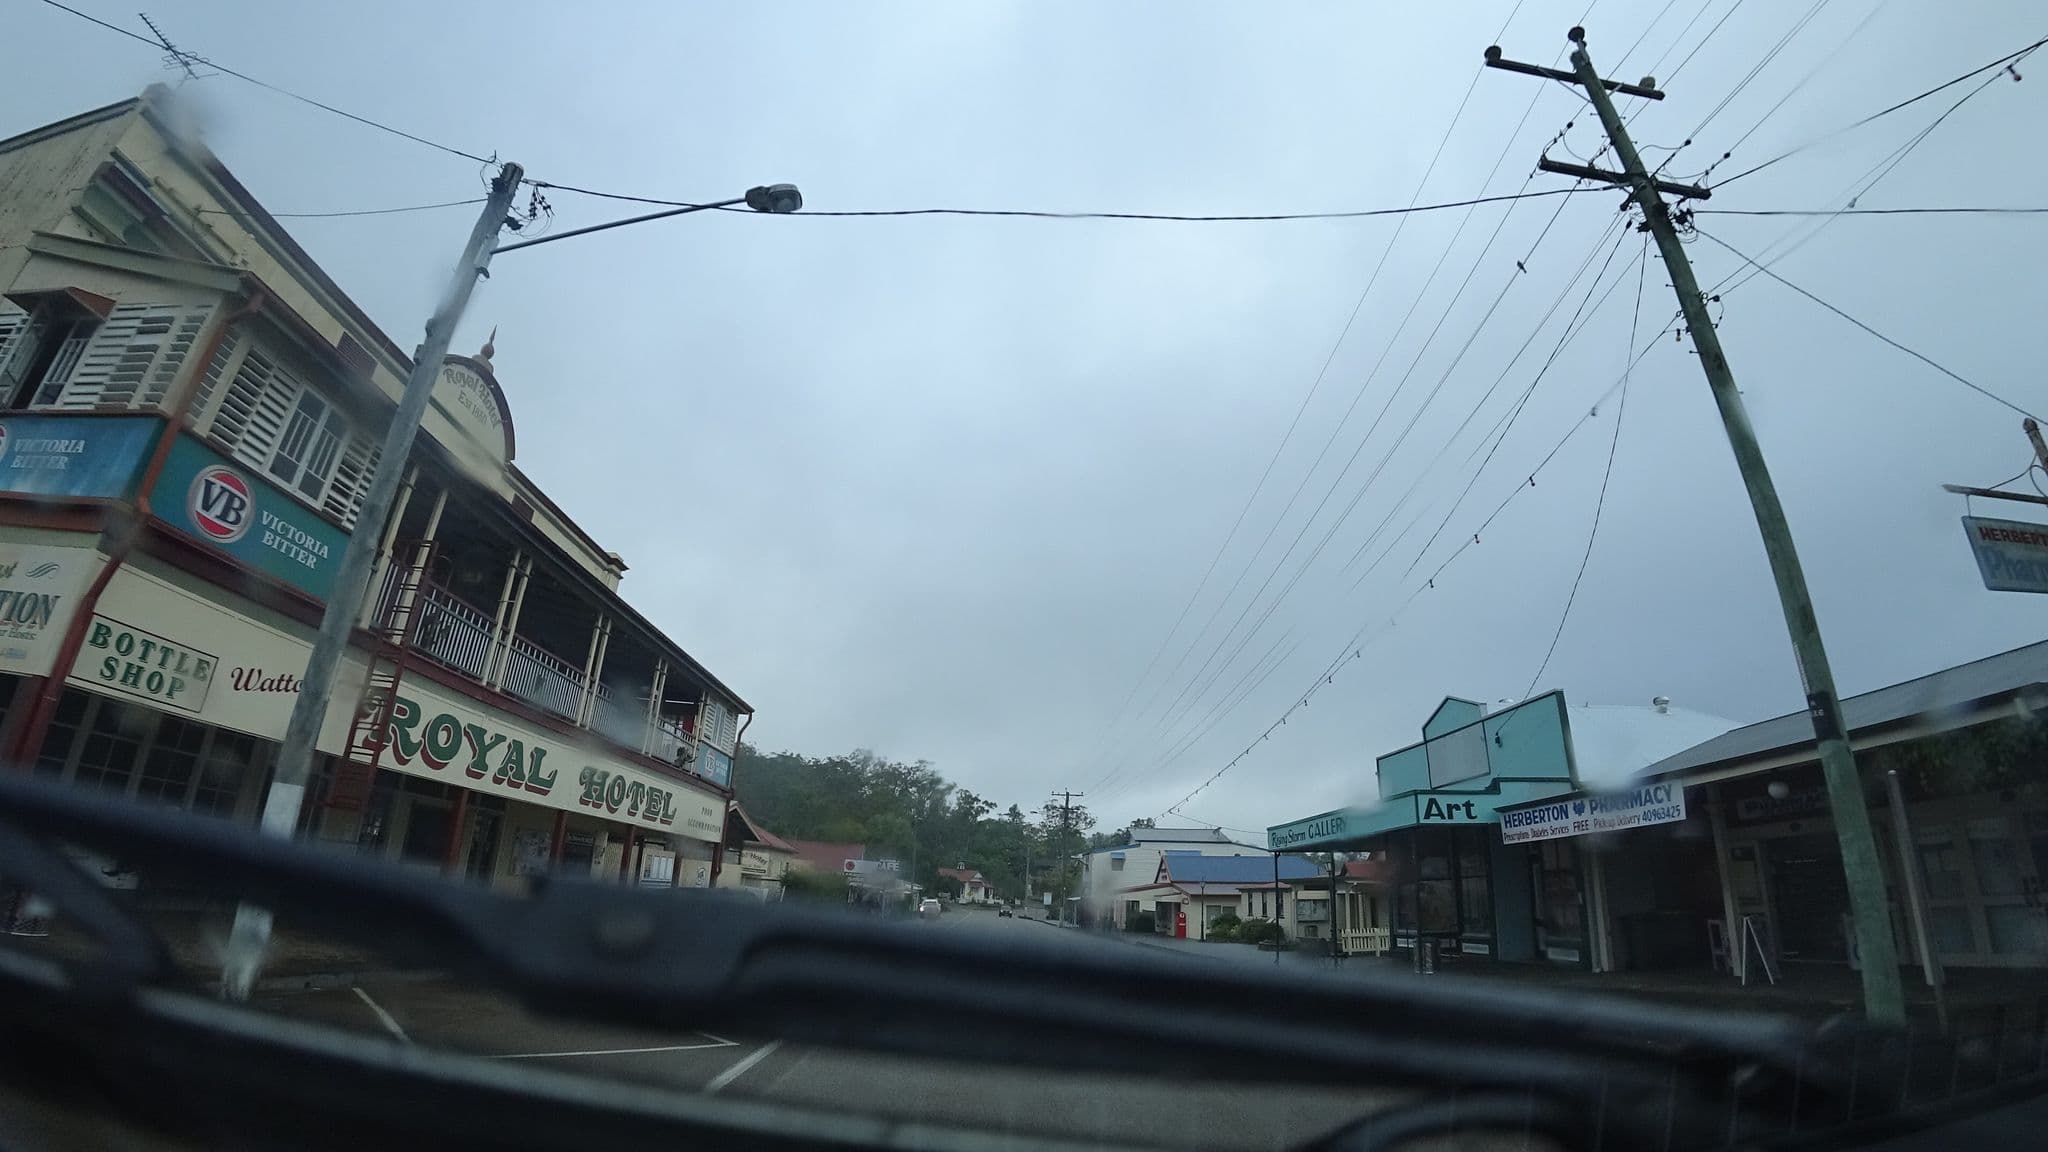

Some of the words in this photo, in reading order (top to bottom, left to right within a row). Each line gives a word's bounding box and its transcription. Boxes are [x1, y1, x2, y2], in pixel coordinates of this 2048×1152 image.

[443, 368, 479, 393] Royal
[10, 455, 68, 470] BITTER
[14, 439, 86, 453] VICTORIA
[201, 479, 246, 525] VB
[260, 510, 329, 559] VICTORIA
[262, 530, 317, 569] BITTER
[89, 622, 210, 682] BOTTLE
[98, 656, 185, 700] SHOP
[362, 696, 557, 797] ROYAL
[578, 766, 676, 826] HOTEL
[1424, 797, 1478, 820] Art
[1503, 804, 1569, 829] HERBERTON
[1589, 784, 1672, 815] PHARMACY
[1572, 819, 1589, 832] FREE
[1641, 804, 1681, 823] 40963425
[1288, 829, 1306, 844] Storm
